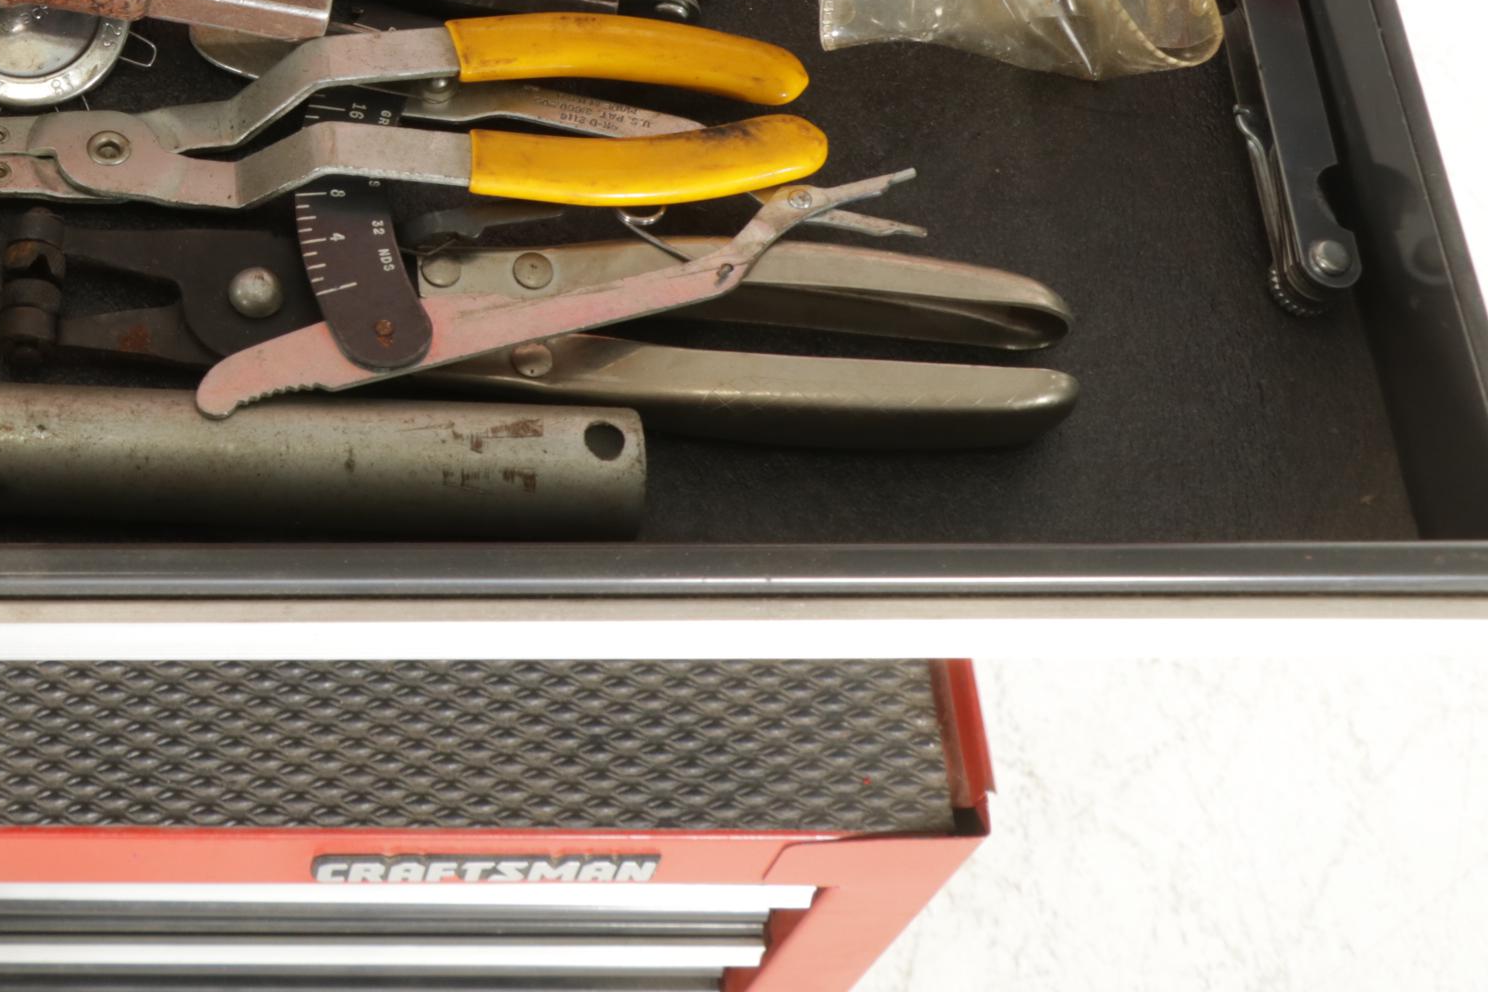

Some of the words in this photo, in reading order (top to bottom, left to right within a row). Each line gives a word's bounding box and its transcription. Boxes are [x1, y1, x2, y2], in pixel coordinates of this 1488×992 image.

[348, 102, 367, 120] 16
[329, 188, 346, 198] 8
[370, 219, 386, 236] 32
[329, 232, 346, 242] 4
[377, 248, 396, 273] NDS
[314, 861, 659, 883] CRAFTSMAN
